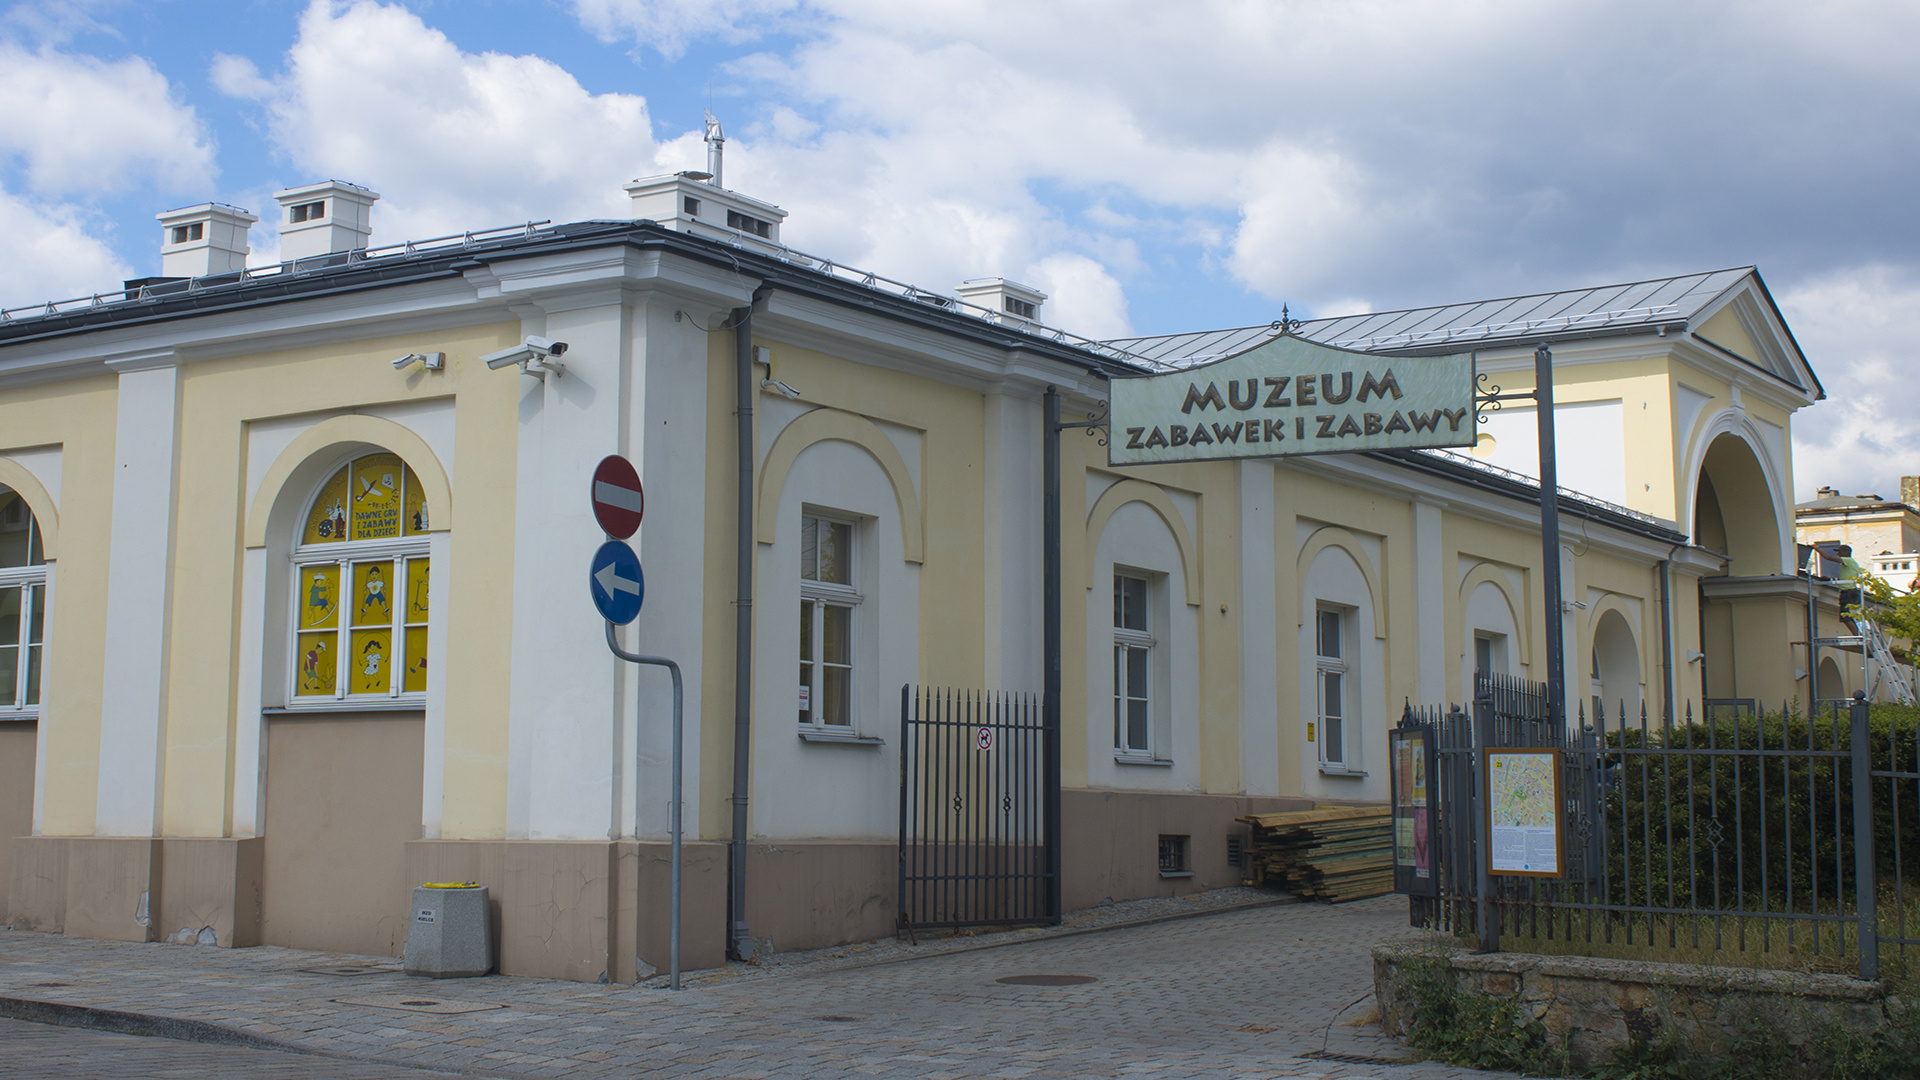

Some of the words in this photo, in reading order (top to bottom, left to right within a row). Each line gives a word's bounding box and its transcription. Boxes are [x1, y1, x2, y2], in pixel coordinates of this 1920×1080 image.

[1181, 367, 1404, 415] MUZEUM
[1126, 419, 1286, 450] ZABAWEK
[1296, 416, 1305, 440] I
[1315, 406, 1467, 438] ZABAWY
[355, 510, 382, 521] DAWNE
[383, 508, 398, 518] GRY
[362, 518, 397, 529] ZABAWY
[357, 530, 371, 539] DLA
